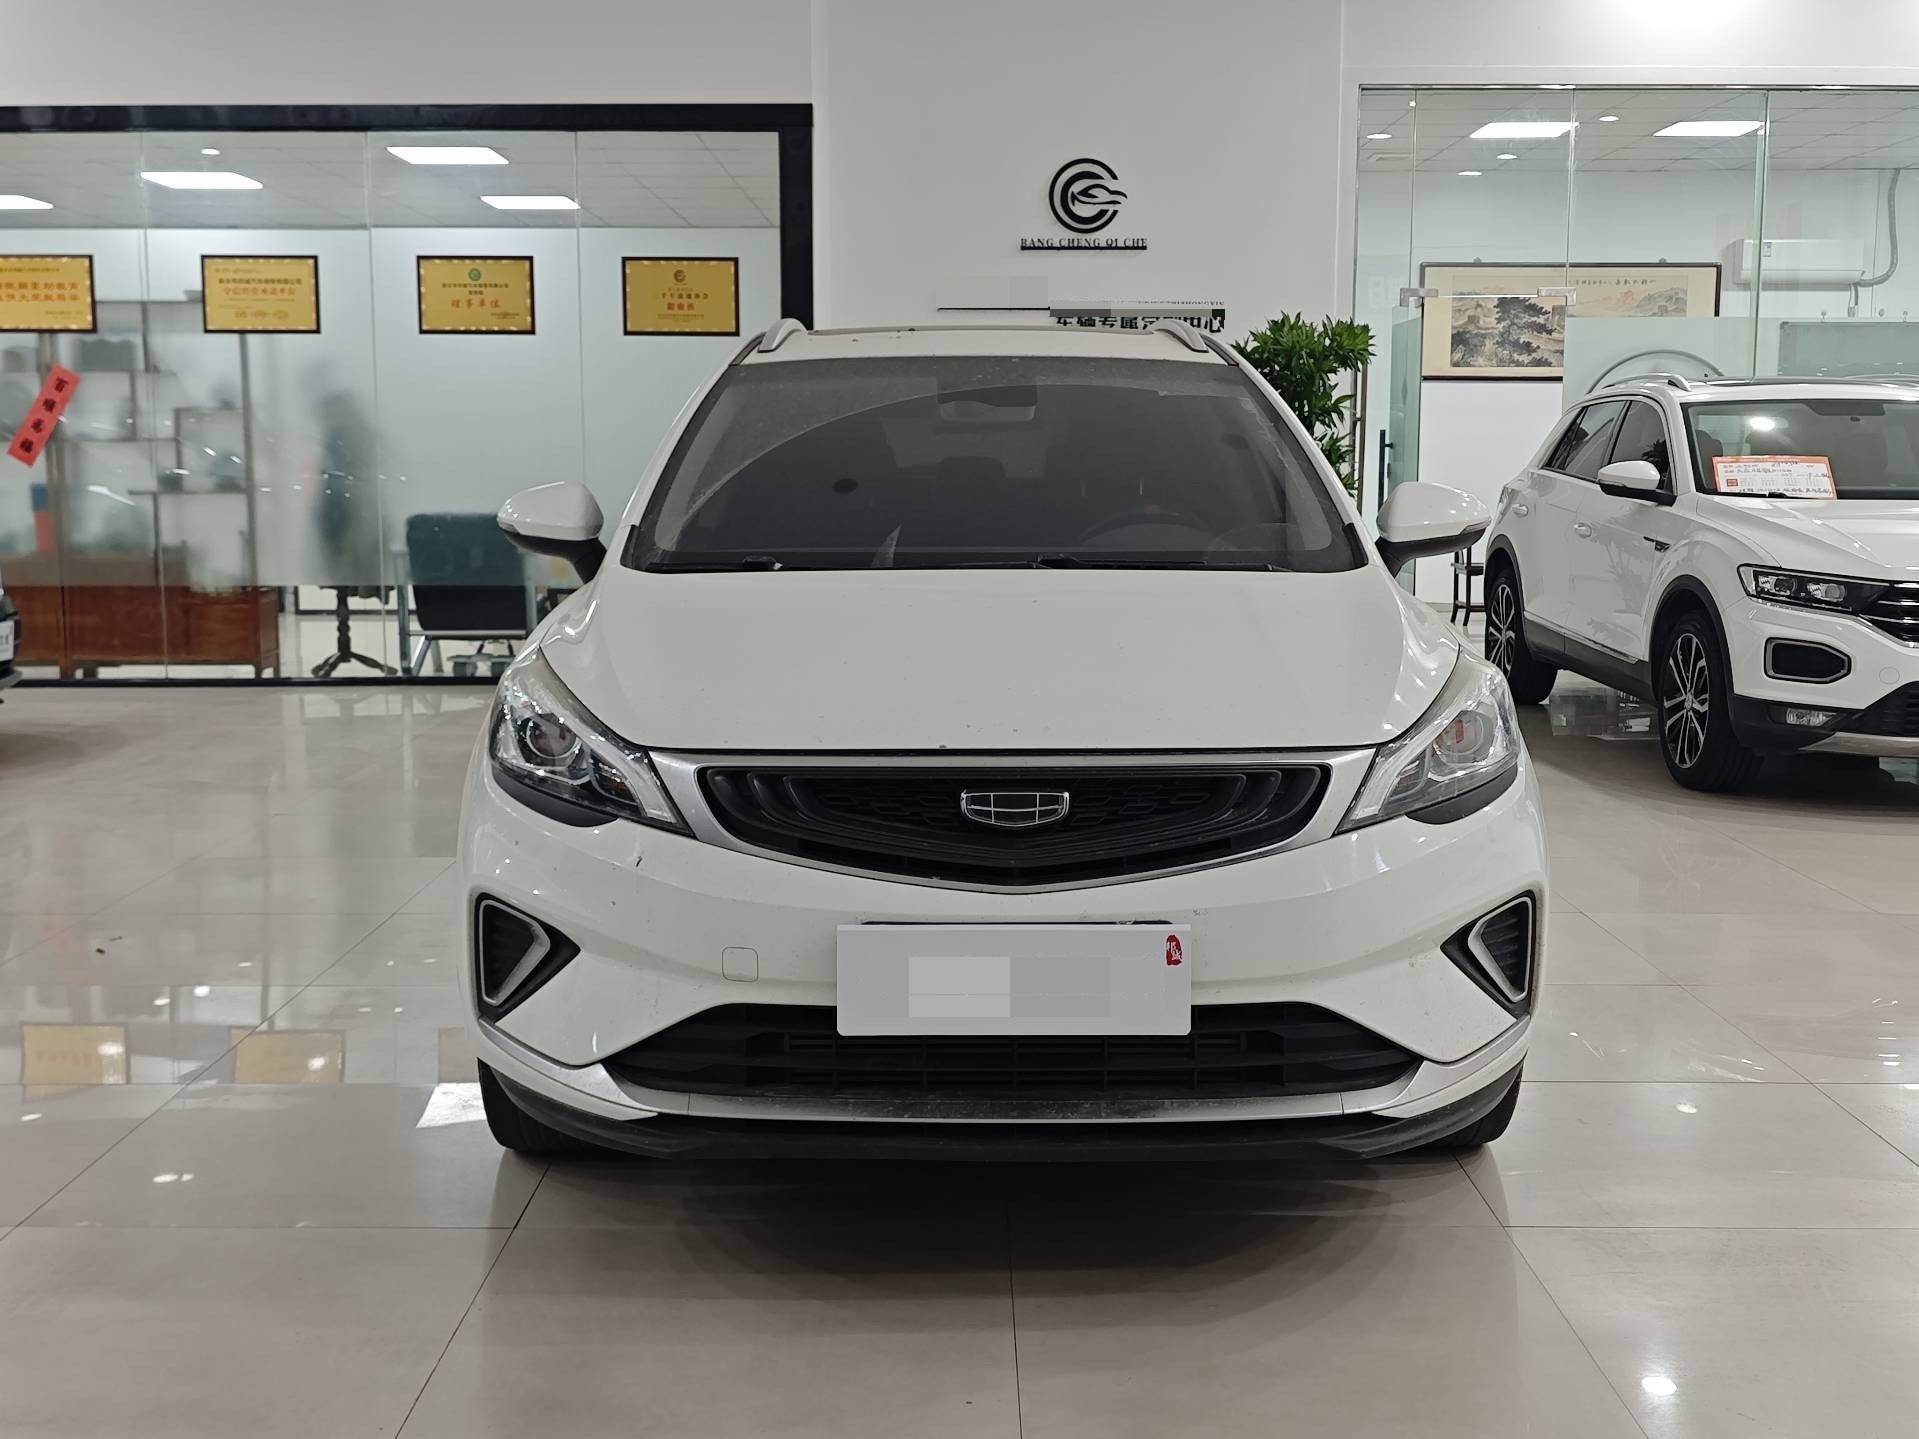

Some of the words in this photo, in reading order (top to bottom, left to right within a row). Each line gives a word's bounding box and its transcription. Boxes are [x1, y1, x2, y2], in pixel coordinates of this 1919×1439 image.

[1020, 238, 1054, 248] BANG
[1058, 238, 1101, 248] CHENG
[1123, 238, 1148, 248] CHE
